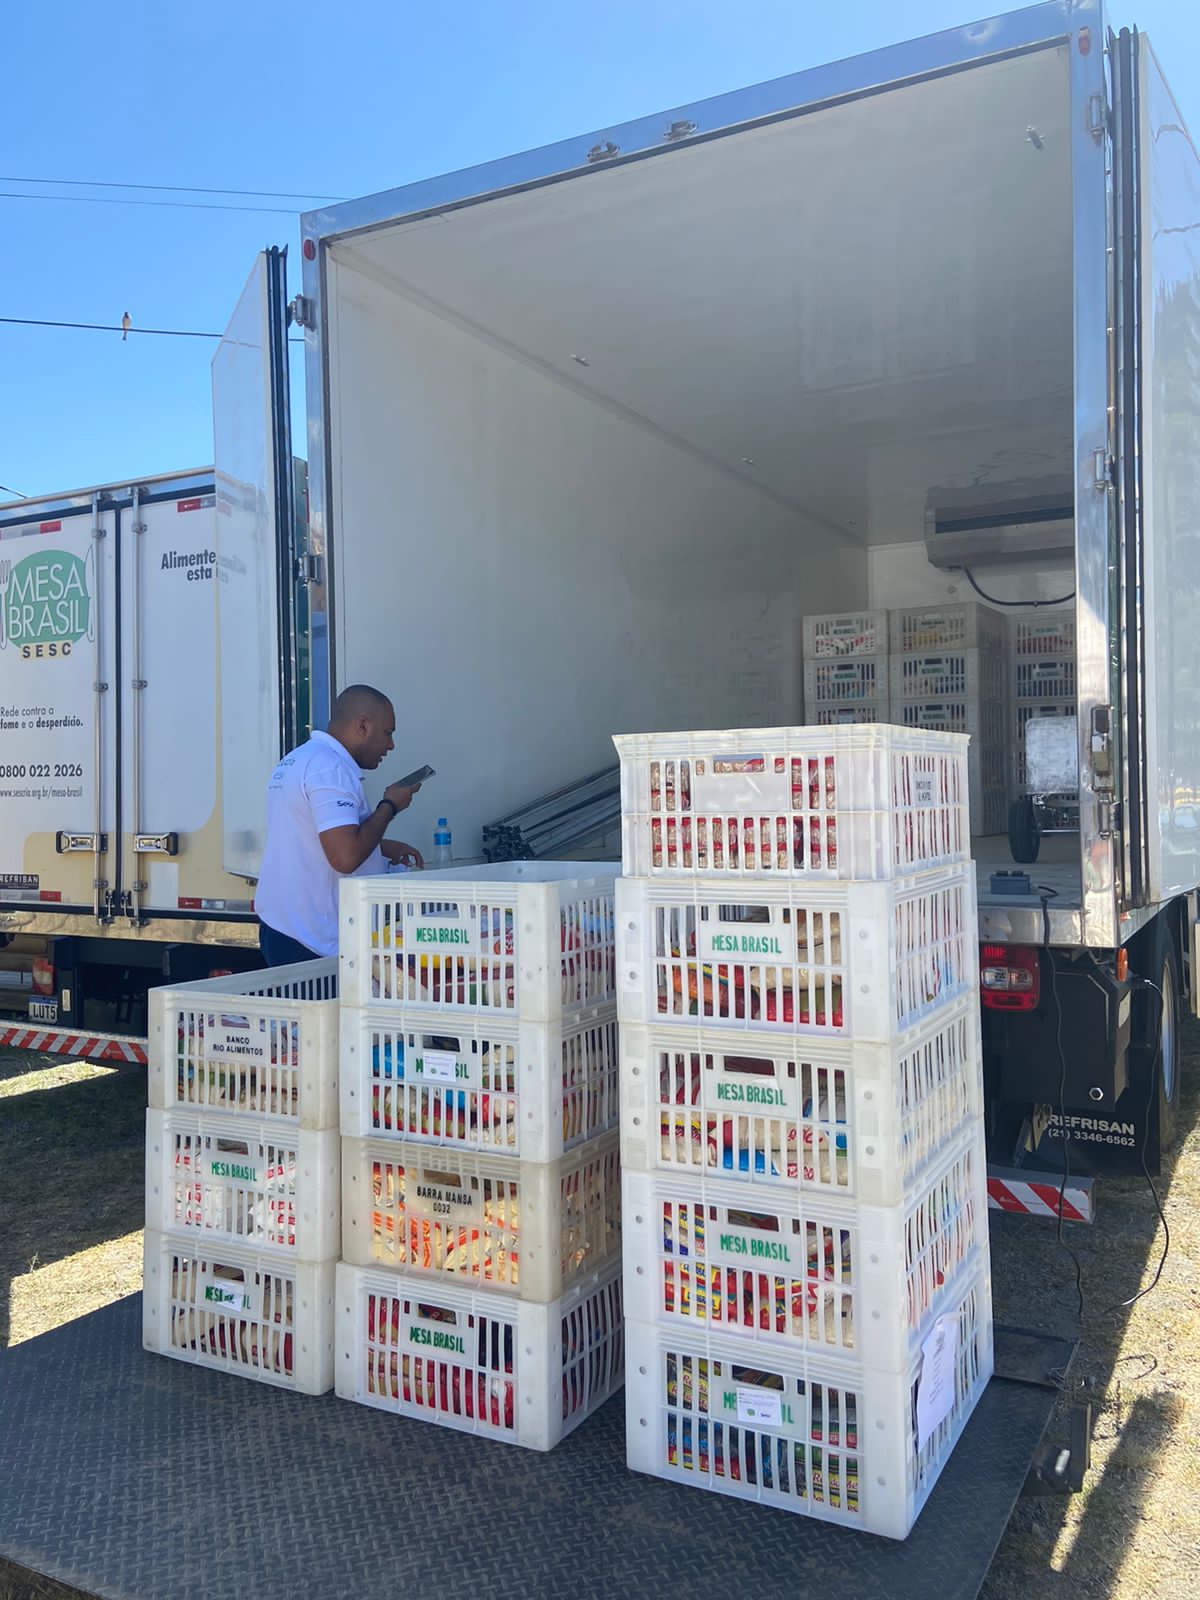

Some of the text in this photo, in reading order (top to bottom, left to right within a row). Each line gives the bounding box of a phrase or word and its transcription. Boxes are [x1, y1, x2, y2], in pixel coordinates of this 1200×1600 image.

[161, 549, 216, 569] Alimente
[10, 562, 85, 604] MESA
[187, 566, 212, 581] esta
[9, 600, 85, 640] BRASIL
[22, 642, 72, 659] SESC
[21, 705, 46, 716] contra
[48, 707, 55, 715] a
[21, 720, 26, 728] e
[28, 720, 34, 728] o
[0, 763, 83, 778] 0800 022 2026
[416, 927, 469, 944] MESA BRASIL
[712, 934, 783, 954] MESA BRASIL
[213, 1044, 263, 1056] RIO ALIMENTOS
[226, 1035, 250, 1045] BANCO
[717, 1082, 787, 1106] MESA BRASIL
[1048, 1114, 1135, 1136] REFRISAN
[1048, 1128, 1071, 1140] (21)
[211, 1161, 257, 1182] MESA BRASIL
[416, 1186, 472, 1206] BARRA MANSA
[720, 1233, 791, 1263] MESA BRASIL
[410, 1326, 465, 1354] MESA BRASIL
